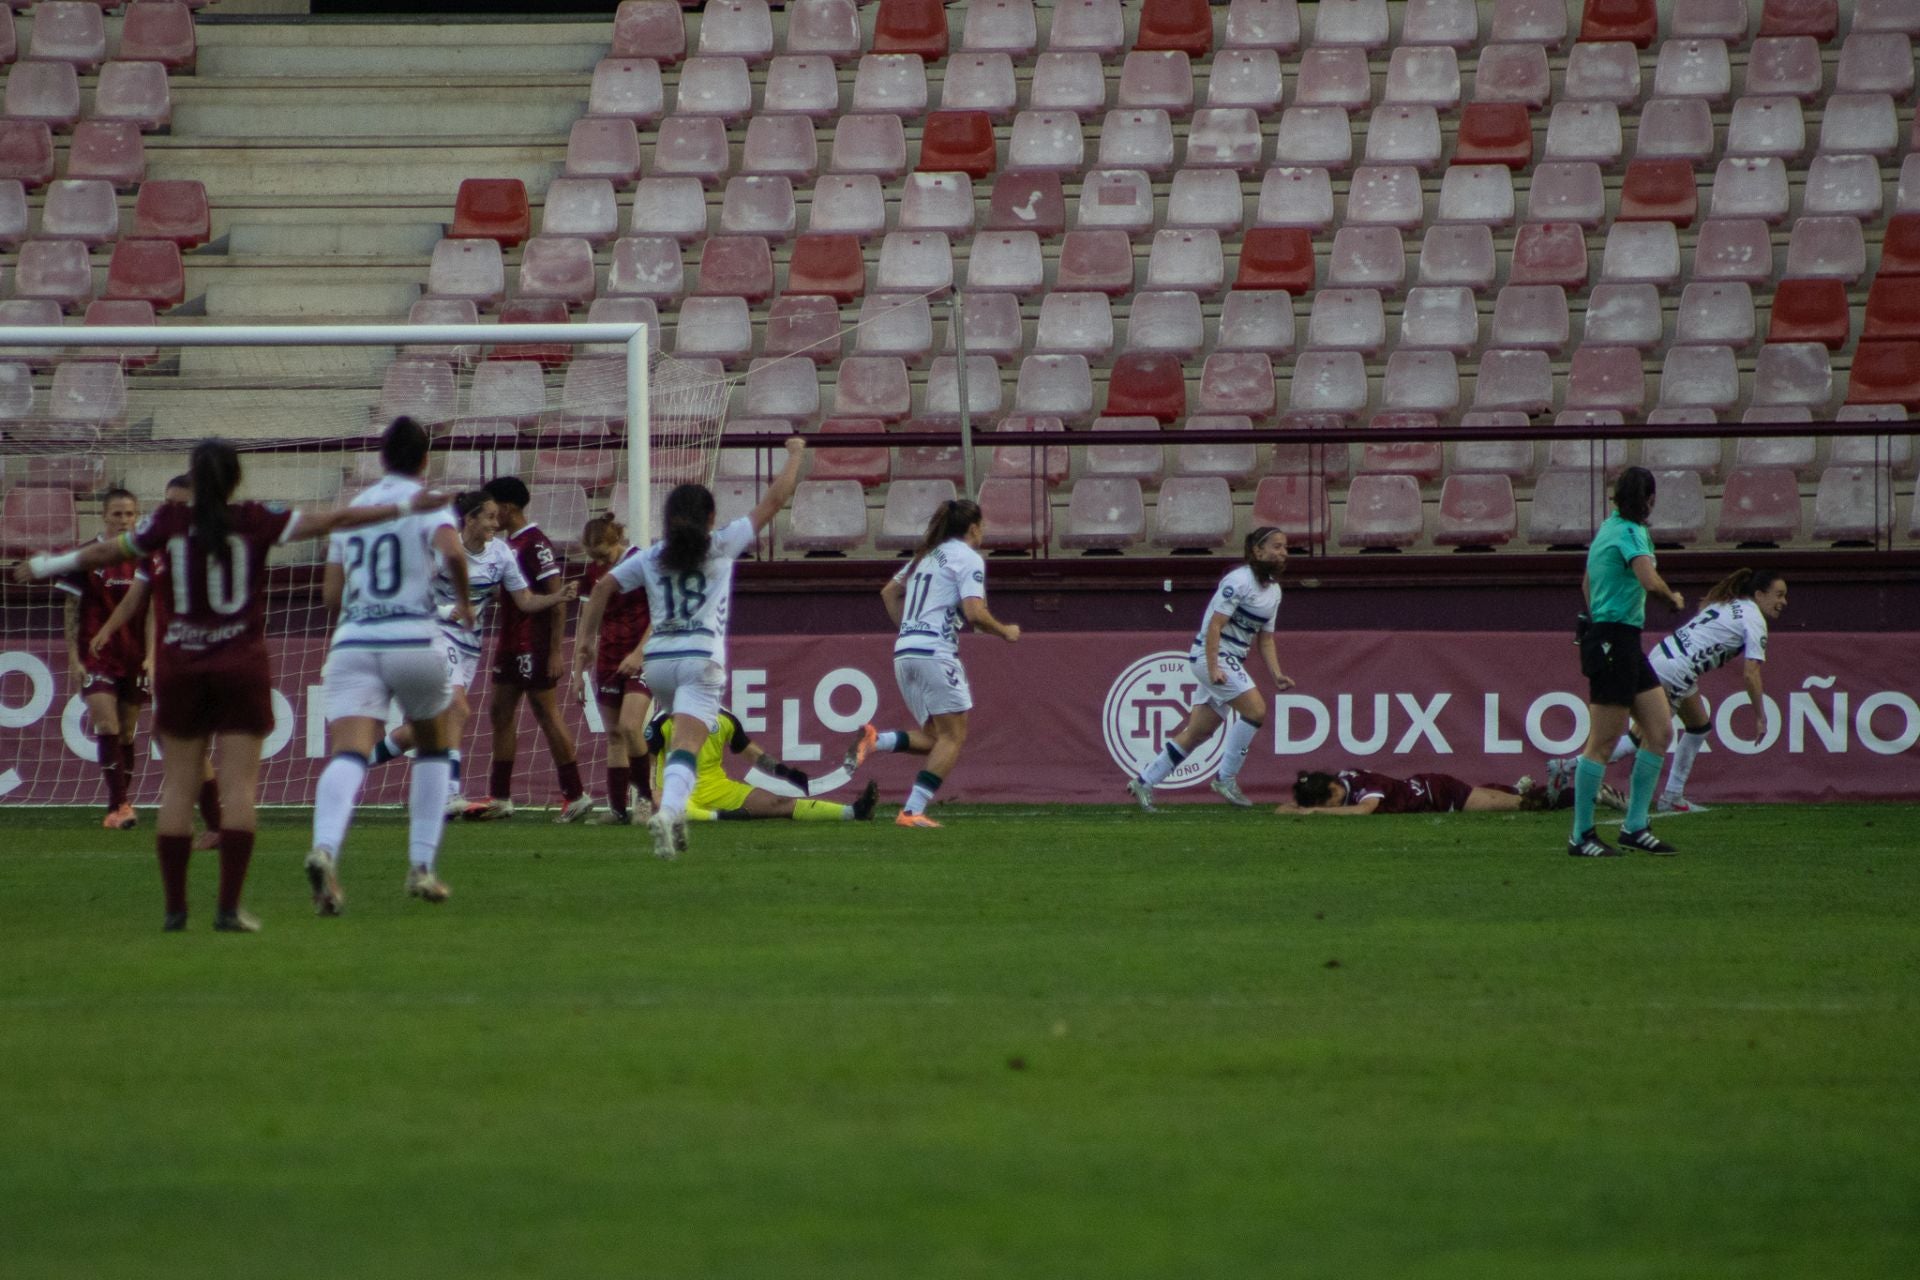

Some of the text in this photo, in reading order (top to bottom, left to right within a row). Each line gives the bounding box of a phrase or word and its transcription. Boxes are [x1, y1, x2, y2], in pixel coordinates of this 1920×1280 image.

[166, 533, 248, 615] 10
[347, 533, 402, 601] 20
[658, 570, 707, 620] 18
[906, 572, 932, 621] 11
[1160, 663, 1185, 673] DUX
[1275, 693, 1453, 755] DUX
[1484, 675, 1920, 755] LOOÑO
